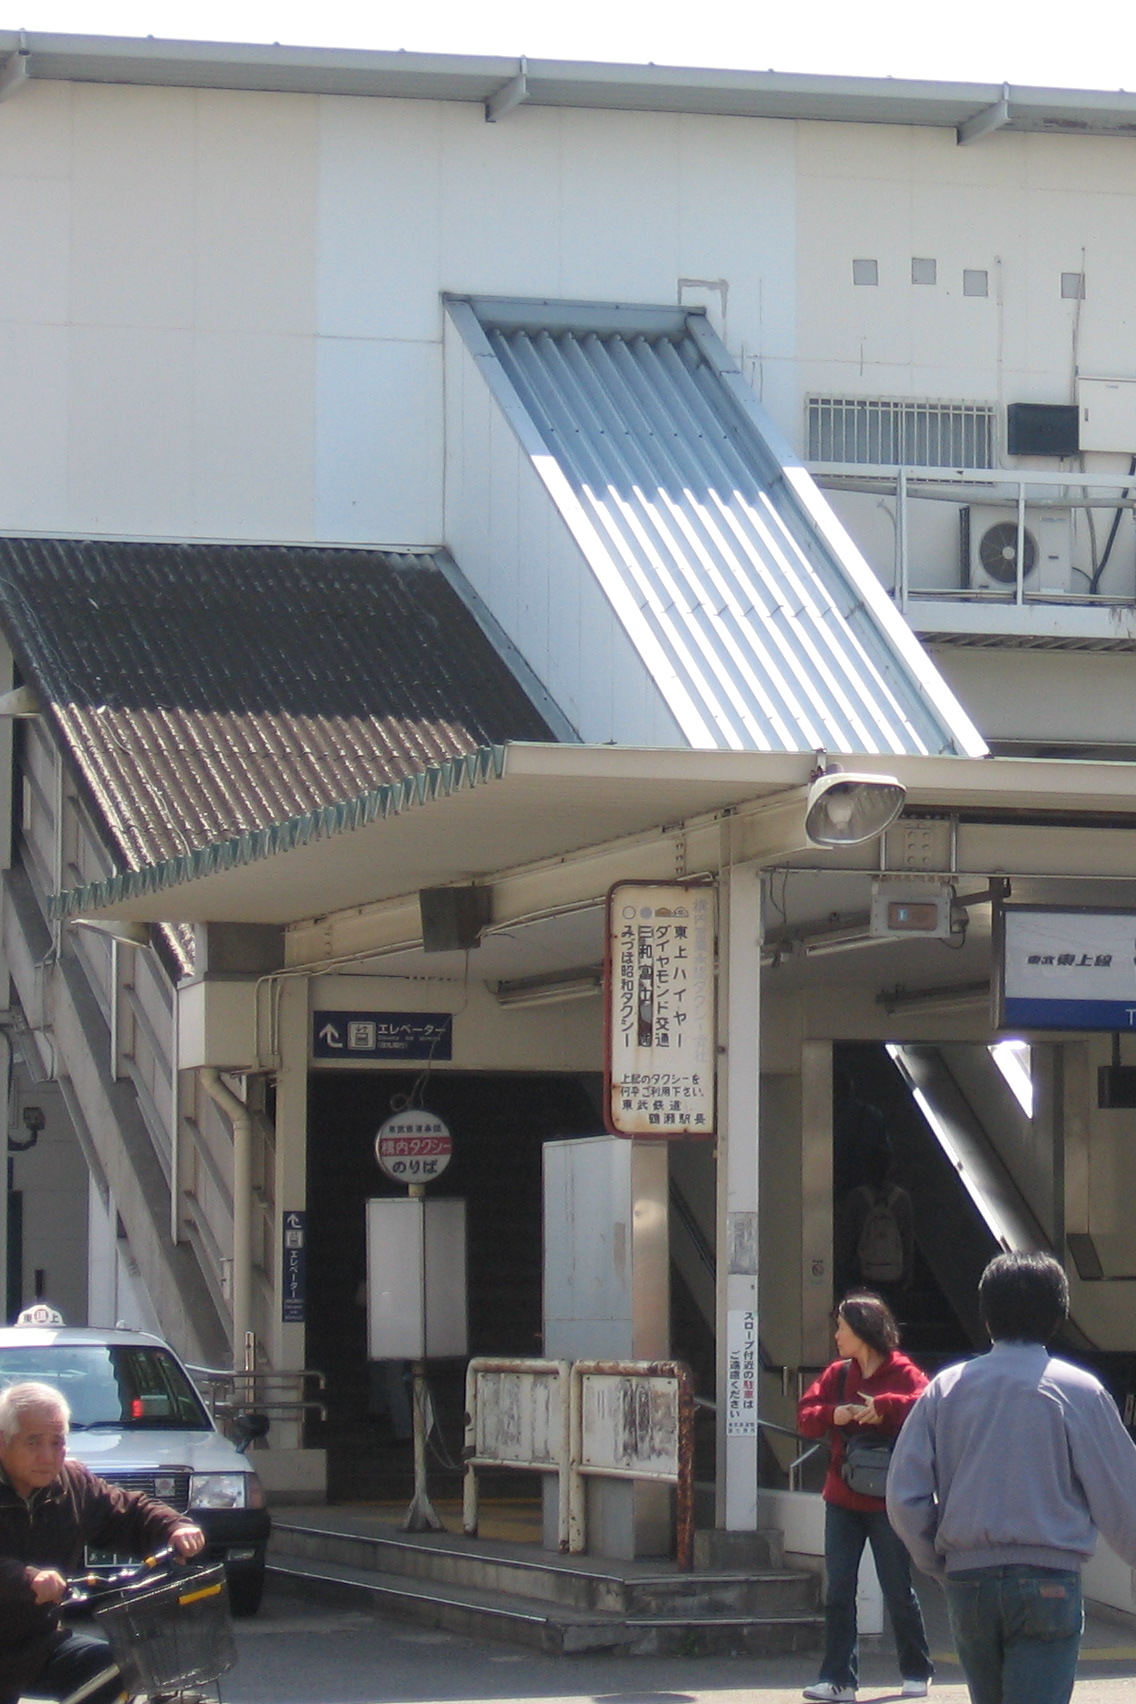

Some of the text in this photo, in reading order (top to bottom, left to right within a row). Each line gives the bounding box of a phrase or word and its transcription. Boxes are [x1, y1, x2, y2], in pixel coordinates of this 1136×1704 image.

[655, 924, 672, 1048] ダイヤモンド交通
[673, 925, 688, 1048] 東上ハイヤー
[377, 1024, 446, 1036] エレベーター
[620, 1073, 701, 1085] 上記のタクシーを
[622, 1099, 682, 1111] 東武鉄道
[649, 1112, 706, 1125] 鶴瀬駅長
[381, 1138, 452, 1155] 構内タクシー
[392, 1159, 438, 1174] のりば
[289, 1250, 299, 1298] エレベーター
[743, 1312, 755, 1410] スロープ付近の駐車は
[729, 1350, 741, 1419] ご遠慮ください
